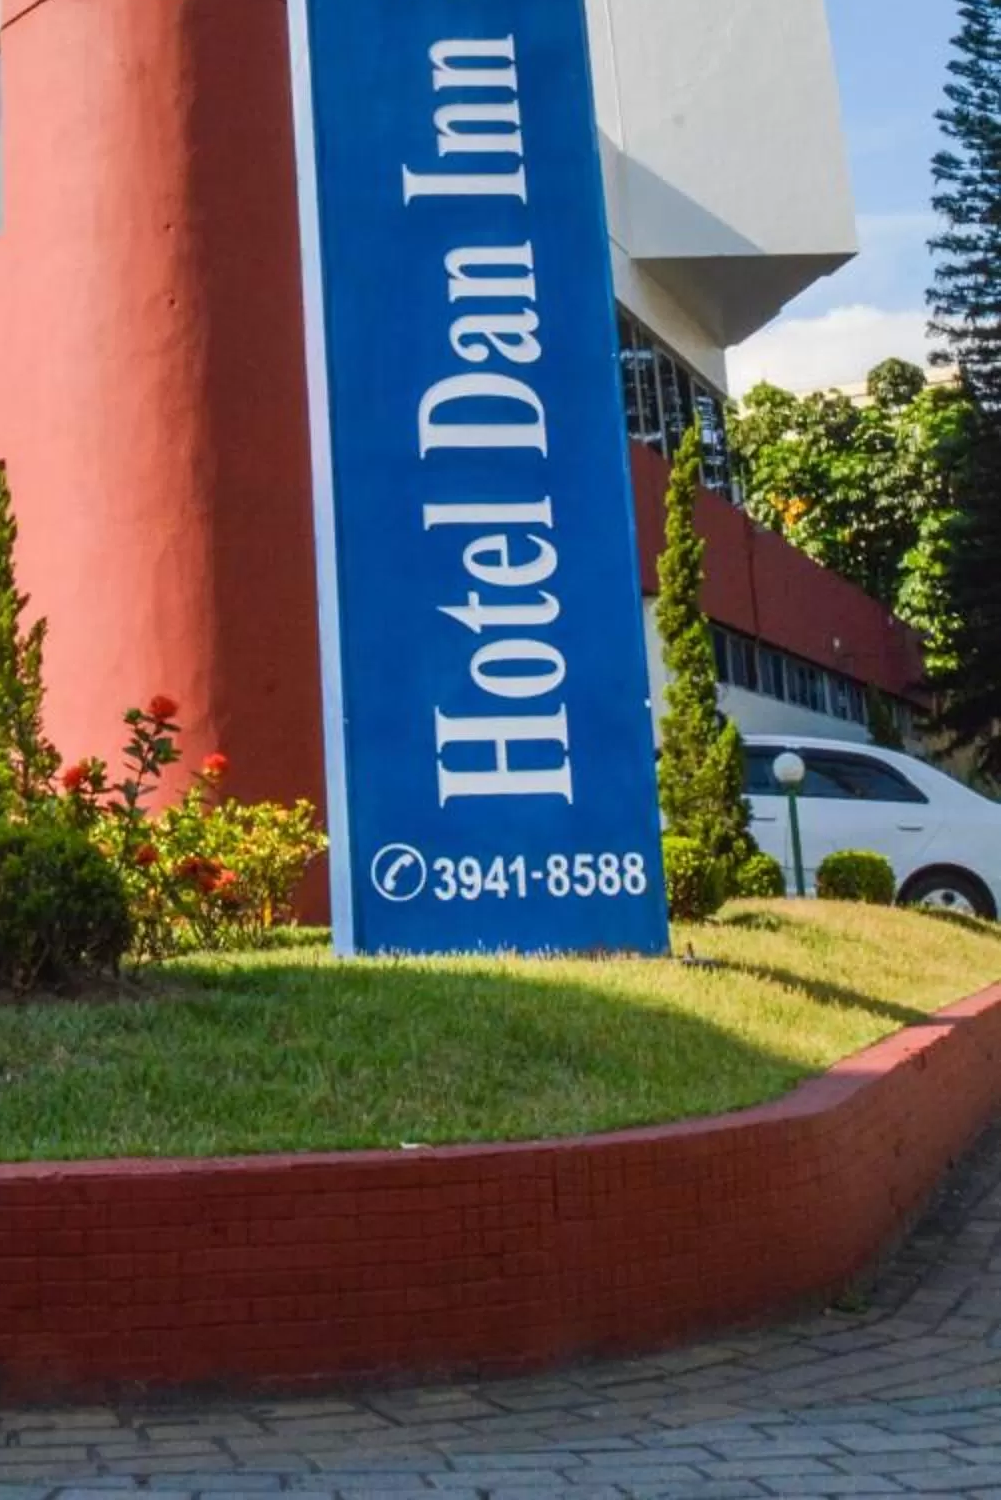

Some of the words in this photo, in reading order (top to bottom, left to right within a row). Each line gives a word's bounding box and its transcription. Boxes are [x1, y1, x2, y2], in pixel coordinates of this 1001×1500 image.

[402, 33, 527, 207] Inn
[417, 240, 548, 460] Dan
[422, 496, 574, 809] Hotel
[433, 853, 647, 900] 3941-8588
